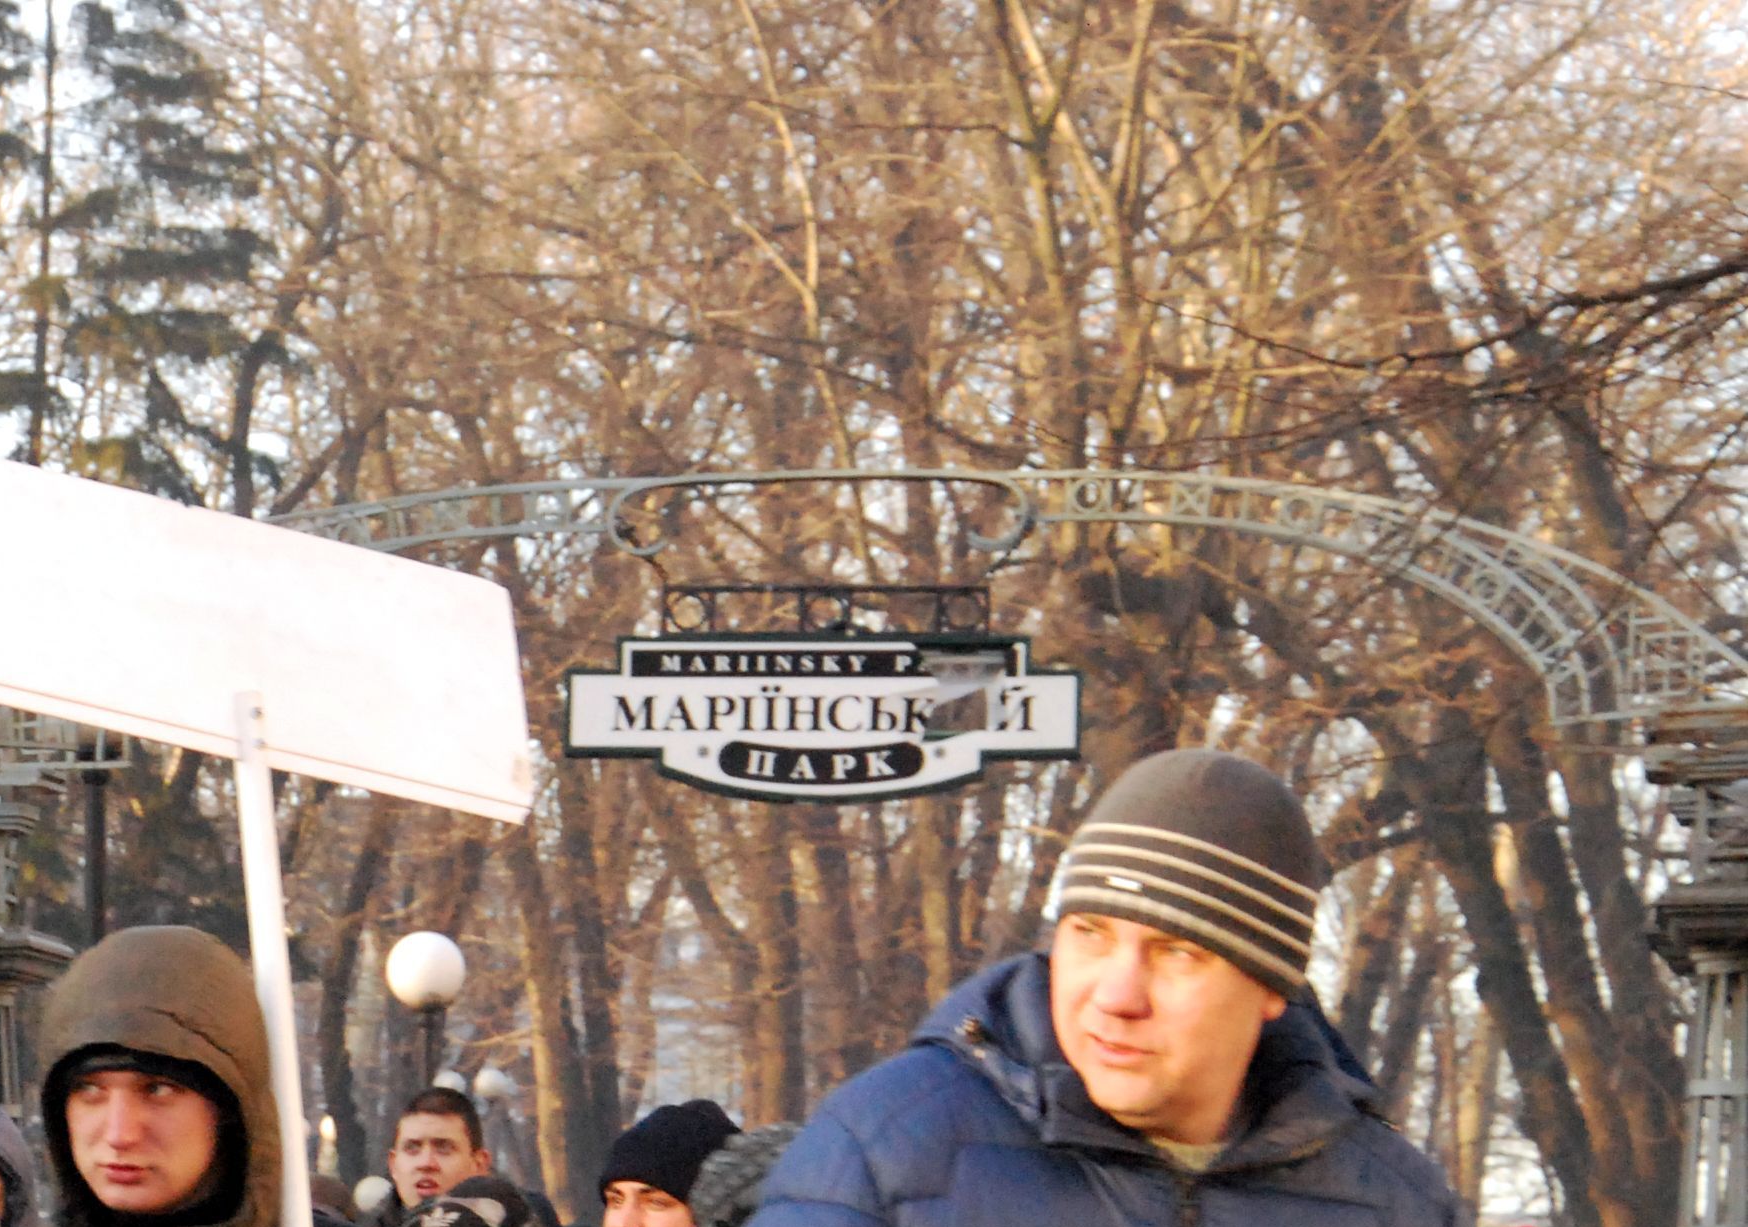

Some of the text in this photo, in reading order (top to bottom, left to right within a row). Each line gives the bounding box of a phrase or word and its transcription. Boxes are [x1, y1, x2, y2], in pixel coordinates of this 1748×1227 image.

[660, 654, 867, 672] MARIINSKY
[613, 685, 1037, 732] МАРІЇНСЬКЙ
[745, 749, 897, 781] ПАРК
